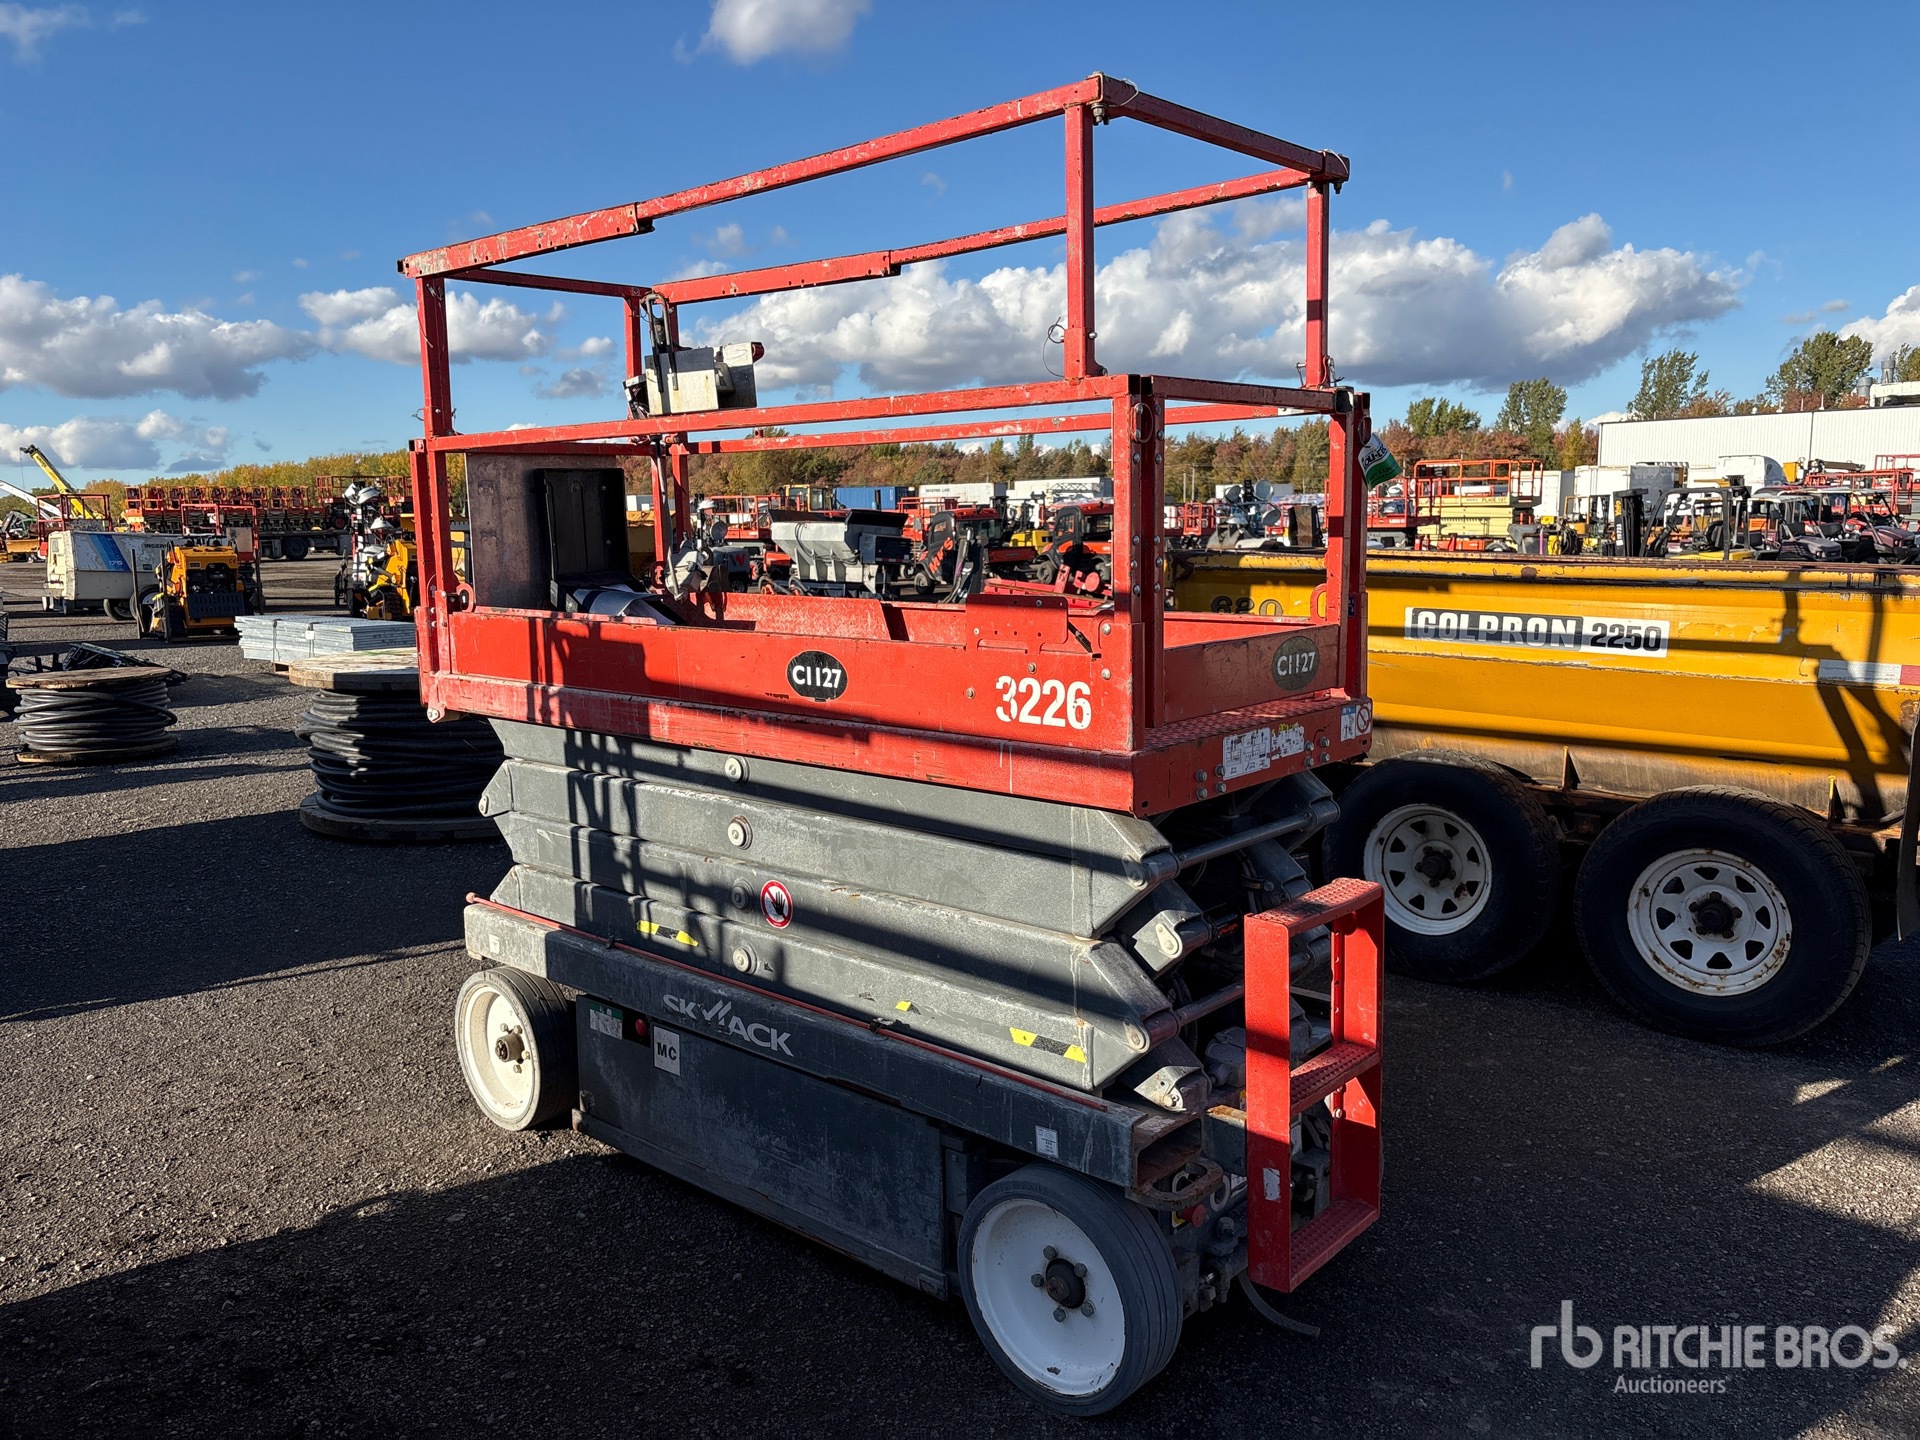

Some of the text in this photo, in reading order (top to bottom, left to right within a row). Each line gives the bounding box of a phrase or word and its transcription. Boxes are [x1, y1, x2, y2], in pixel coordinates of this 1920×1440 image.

[1416, 610, 1663, 653] COLPRON 2250
[995, 674, 1093, 731] 3226
[656, 1041, 678, 1062] MC
